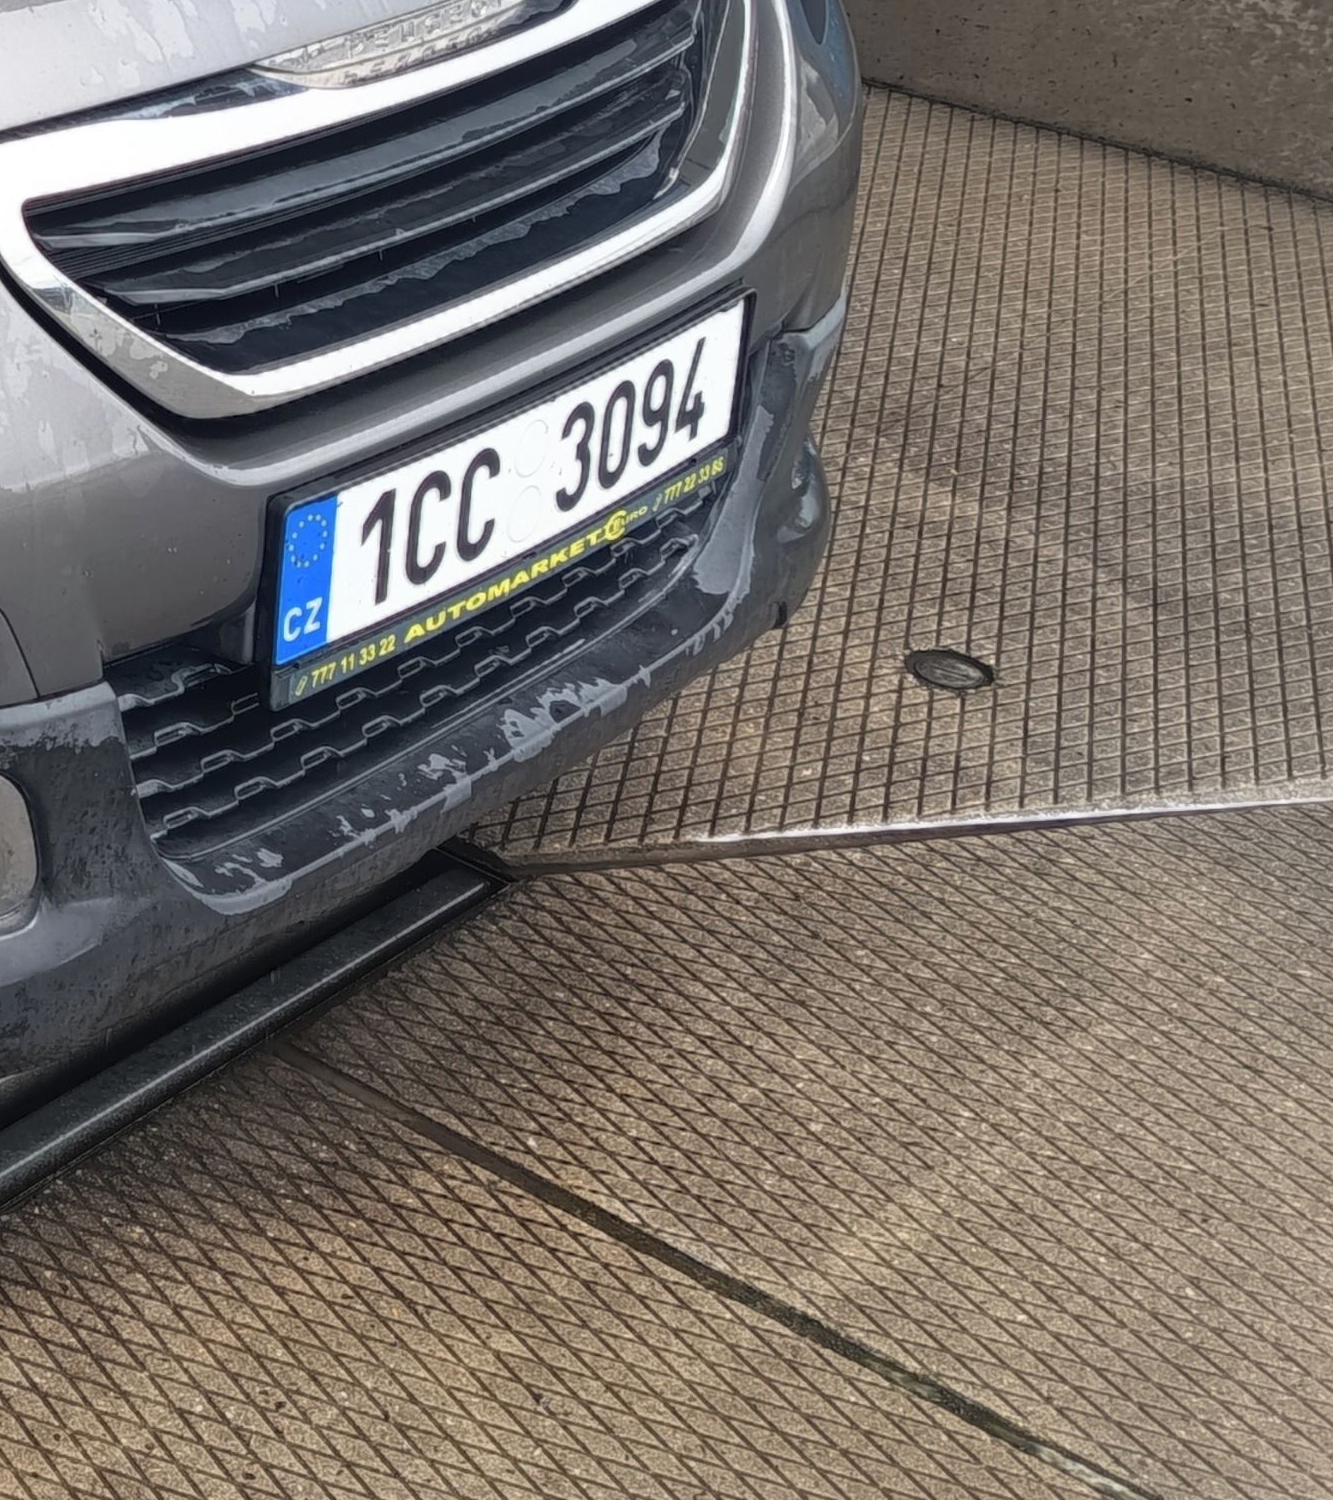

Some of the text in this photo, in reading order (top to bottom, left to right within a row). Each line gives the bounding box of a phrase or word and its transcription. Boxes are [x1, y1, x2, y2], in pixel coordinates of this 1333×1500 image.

[361, 335, 707, 606] 1CC 3094
[282, 596, 322, 642] CZ
[311, 662, 337, 688] 777
[340, 652, 355, 674] 11
[358, 643, 376, 667] 33
[379, 634, 397, 656] 22
[403, 530, 603, 644] AUTOMARKET
